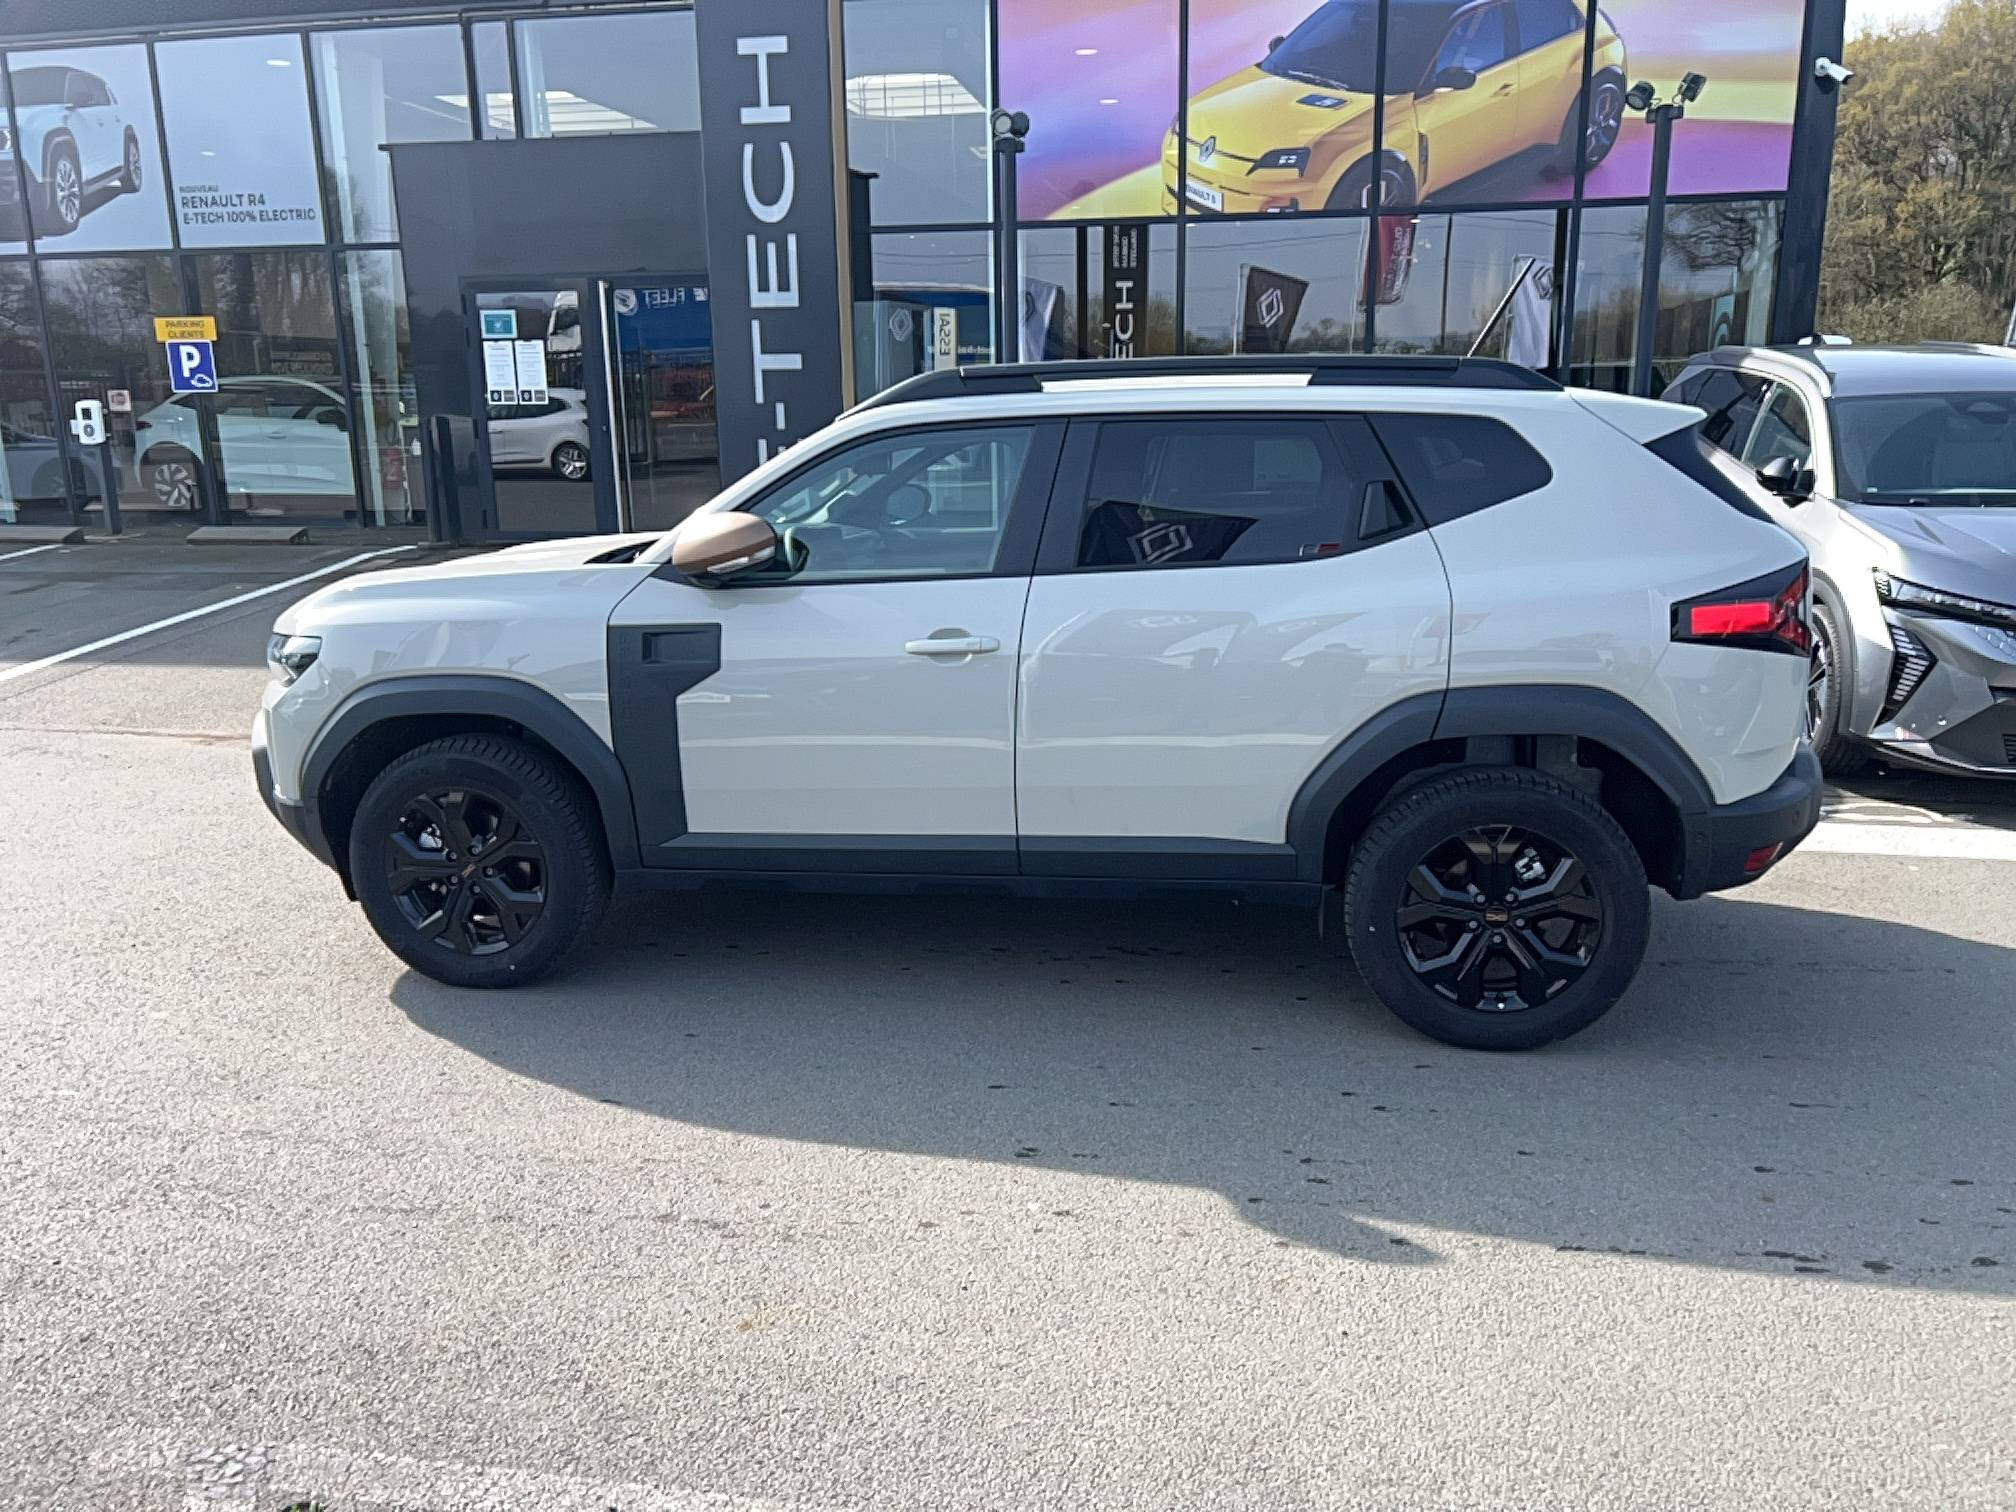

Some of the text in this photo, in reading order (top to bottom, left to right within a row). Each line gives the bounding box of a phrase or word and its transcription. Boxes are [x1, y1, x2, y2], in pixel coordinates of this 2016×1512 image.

[181, 192, 266, 209] RENAULT R4
[183, 207, 316, 225] E-TECH 100% ELECTRIC
[165, 320, 205, 329] PARKING
[168, 330, 205, 339] CLIENTS
[179, 345, 201, 378] P
